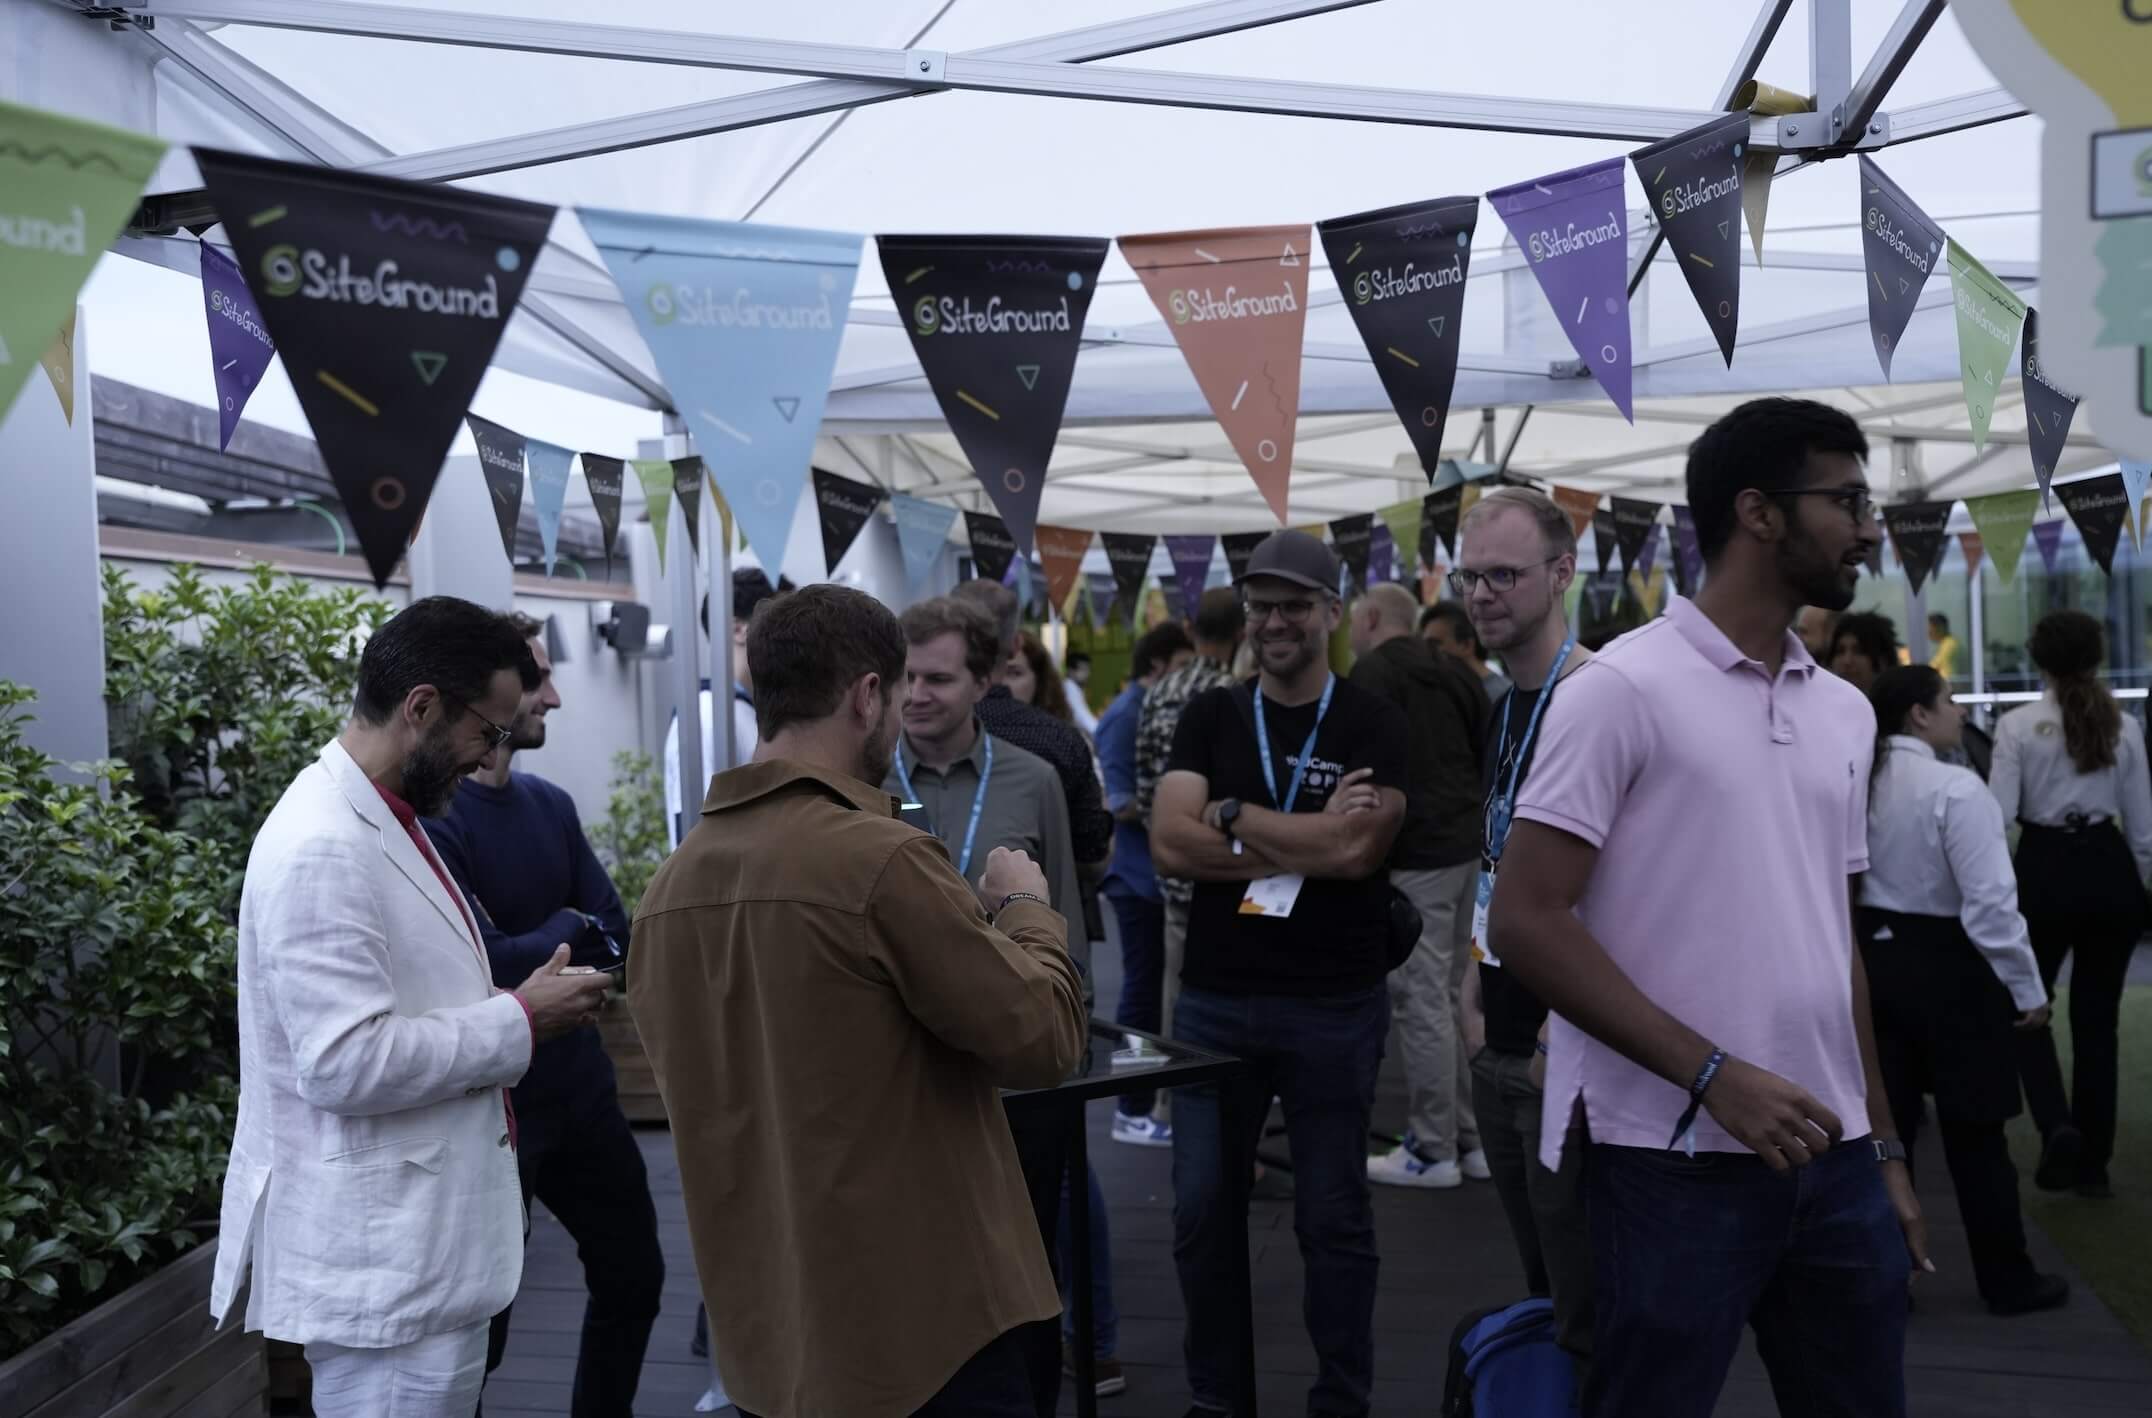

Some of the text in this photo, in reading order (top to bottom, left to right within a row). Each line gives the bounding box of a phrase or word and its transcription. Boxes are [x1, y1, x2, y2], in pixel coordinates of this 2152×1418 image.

[1677, 164, 1739, 214] SiteGround
[0, 206, 86, 256] und
[1543, 212, 1620, 259] SiteGround
[1875, 211, 1929, 273] SiteGround
[302, 250, 499, 318] SiteGround
[1371, 254, 1462, 301] SiteGround
[678, 288, 832, 330] SiteGround
[940, 296, 1070, 334] SiteGround
[1187, 282, 1297, 322] SiteGround
[1965, 296, 2010, 346] SiteGround
